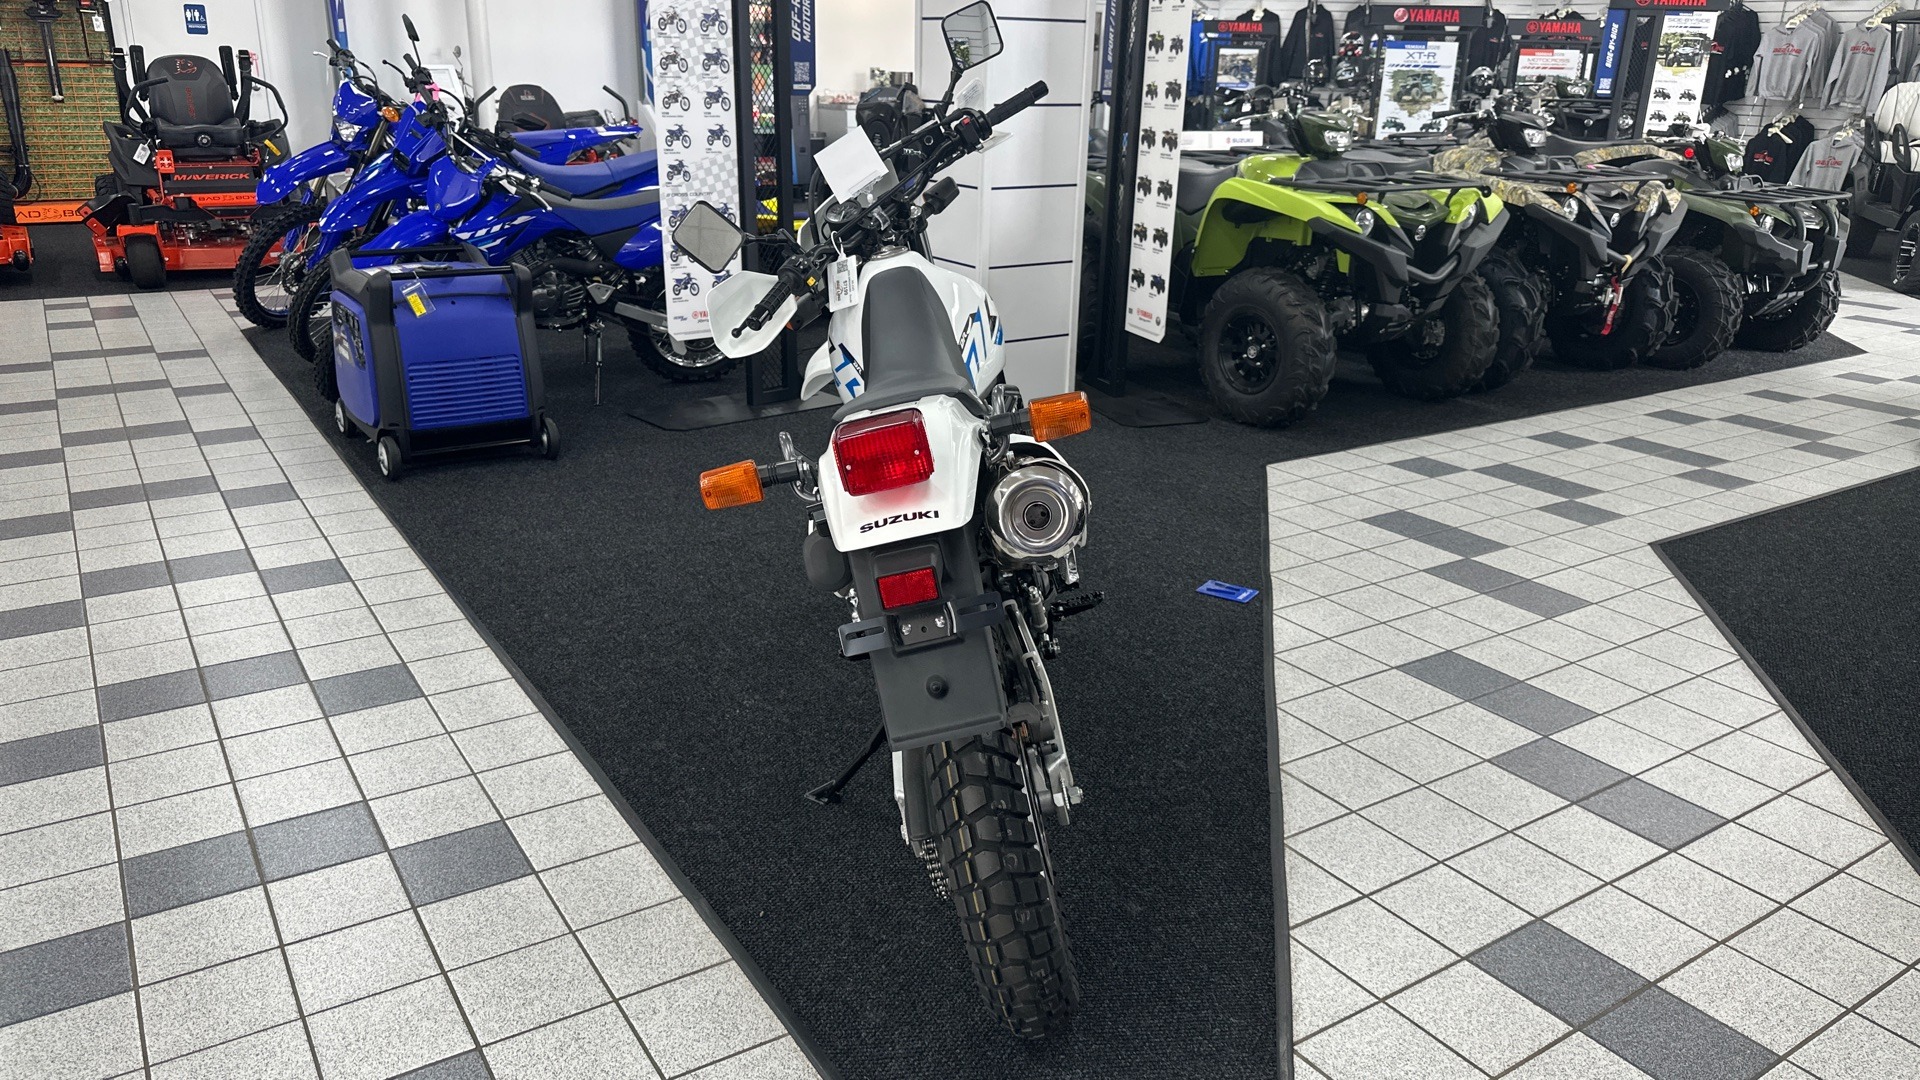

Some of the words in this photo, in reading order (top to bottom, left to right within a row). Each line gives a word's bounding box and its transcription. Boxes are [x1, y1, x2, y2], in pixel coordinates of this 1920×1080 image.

[1409, 8, 1460, 23] YAMAHA
[1228, 22, 1263, 32] YAMAHA
[1540, 22, 1582, 34] YAMAHA
[1107, 25, 1115, 63] SPORT
[1604, 22, 1619, 69] SIDE-BY-SIDE
[1405, 51, 1437, 60] XT-R
[173, 173, 250, 181] MAVERICK
[860, 510, 940, 534] SUZUKI
